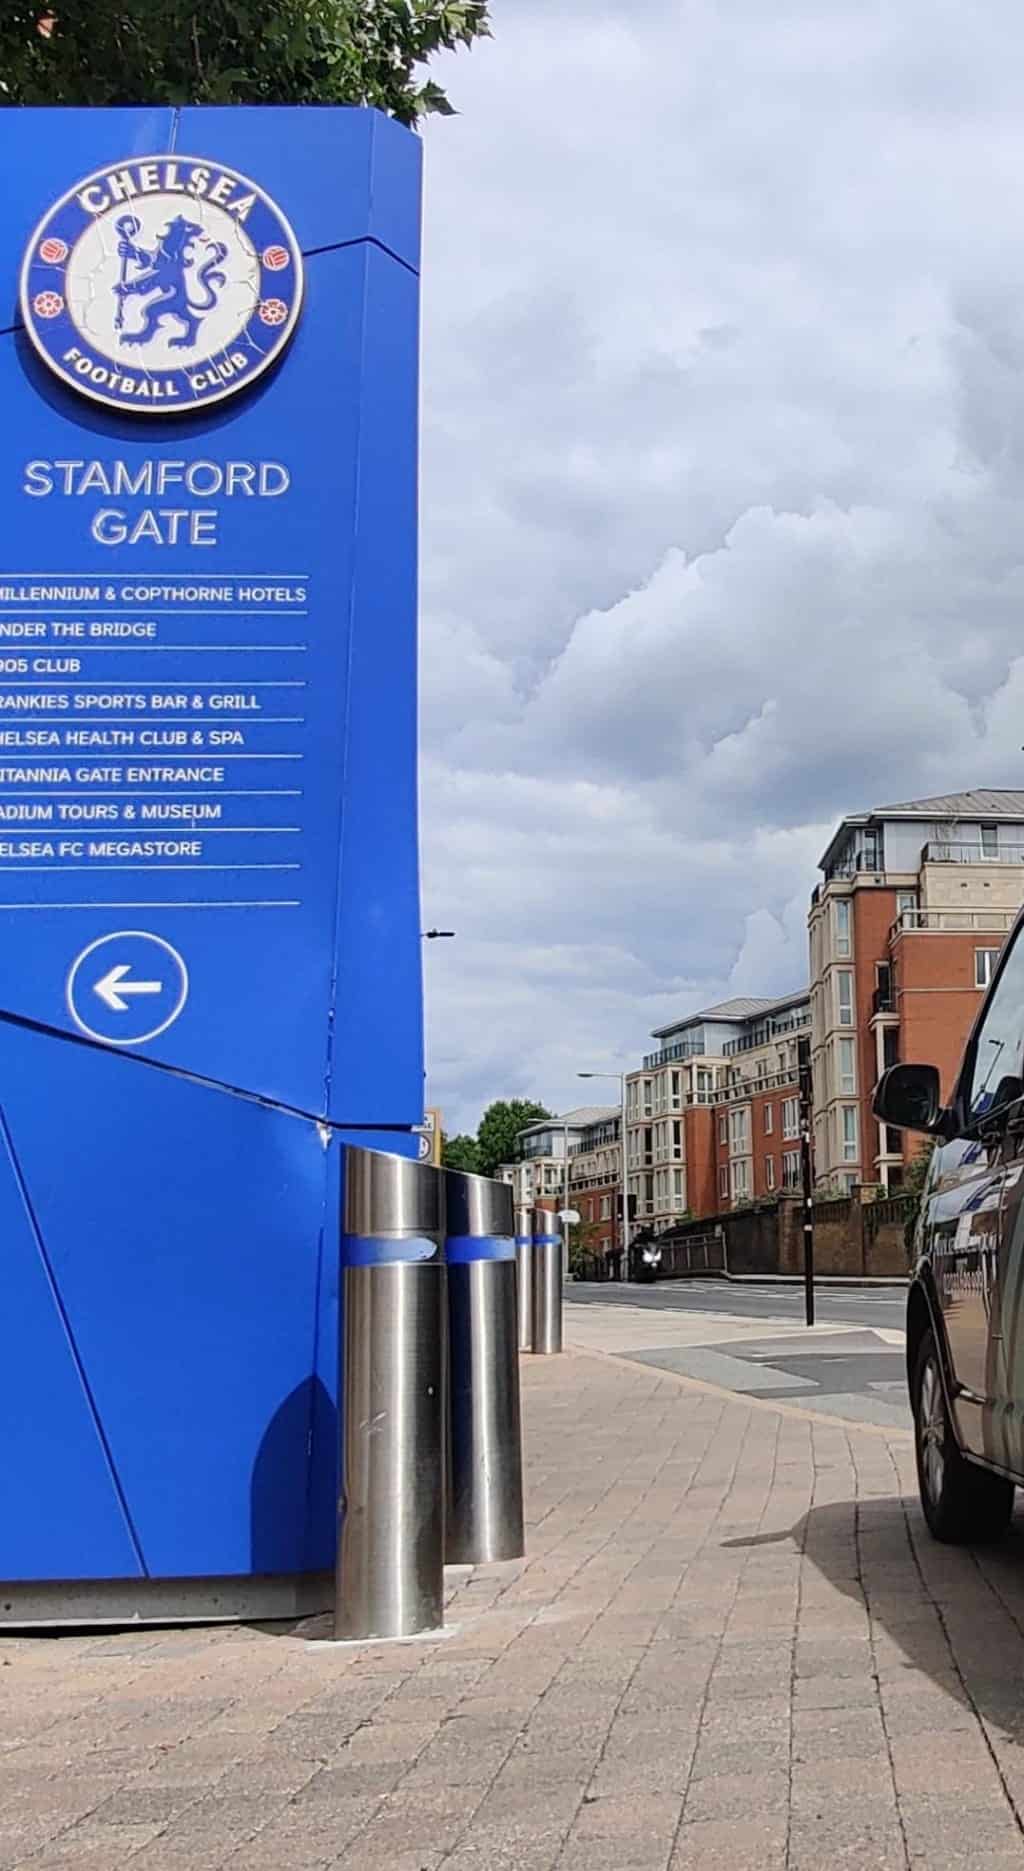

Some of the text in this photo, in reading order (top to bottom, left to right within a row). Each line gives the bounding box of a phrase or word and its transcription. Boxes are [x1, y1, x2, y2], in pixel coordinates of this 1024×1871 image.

[77, 164, 257, 221] CHELSEA
[62, 347, 248, 397] FOOTBALL CLUB
[23, 460, 290, 496] STAMFORD
[91, 509, 218, 546] GATE
[105, 586, 116, 601] &
[121, 586, 233, 601] COPTHORNE
[239, 587, 306, 602] HOTELS
[52, 622, 85, 637] THE
[90, 622, 156, 637] BRIDGE
[33, 658, 81, 673] CLUB
[74, 694, 147, 709] SPORTS
[151, 694, 188, 709] BAR
[192, 694, 204, 709] &
[209, 695, 260, 709] GRILL
[0, 730, 244, 745] ELSEA HEALTH CLUB & SPA
[76, 767, 122, 782] GATE
[127, 767, 224, 782] ENTRANCE
[59, 804, 119, 819] TOURS
[124, 804, 136, 819] &
[141, 804, 221, 819] MUSEUM
[60, 842, 84, 857] FC
[89, 841, 201, 857] MEGASTORE
